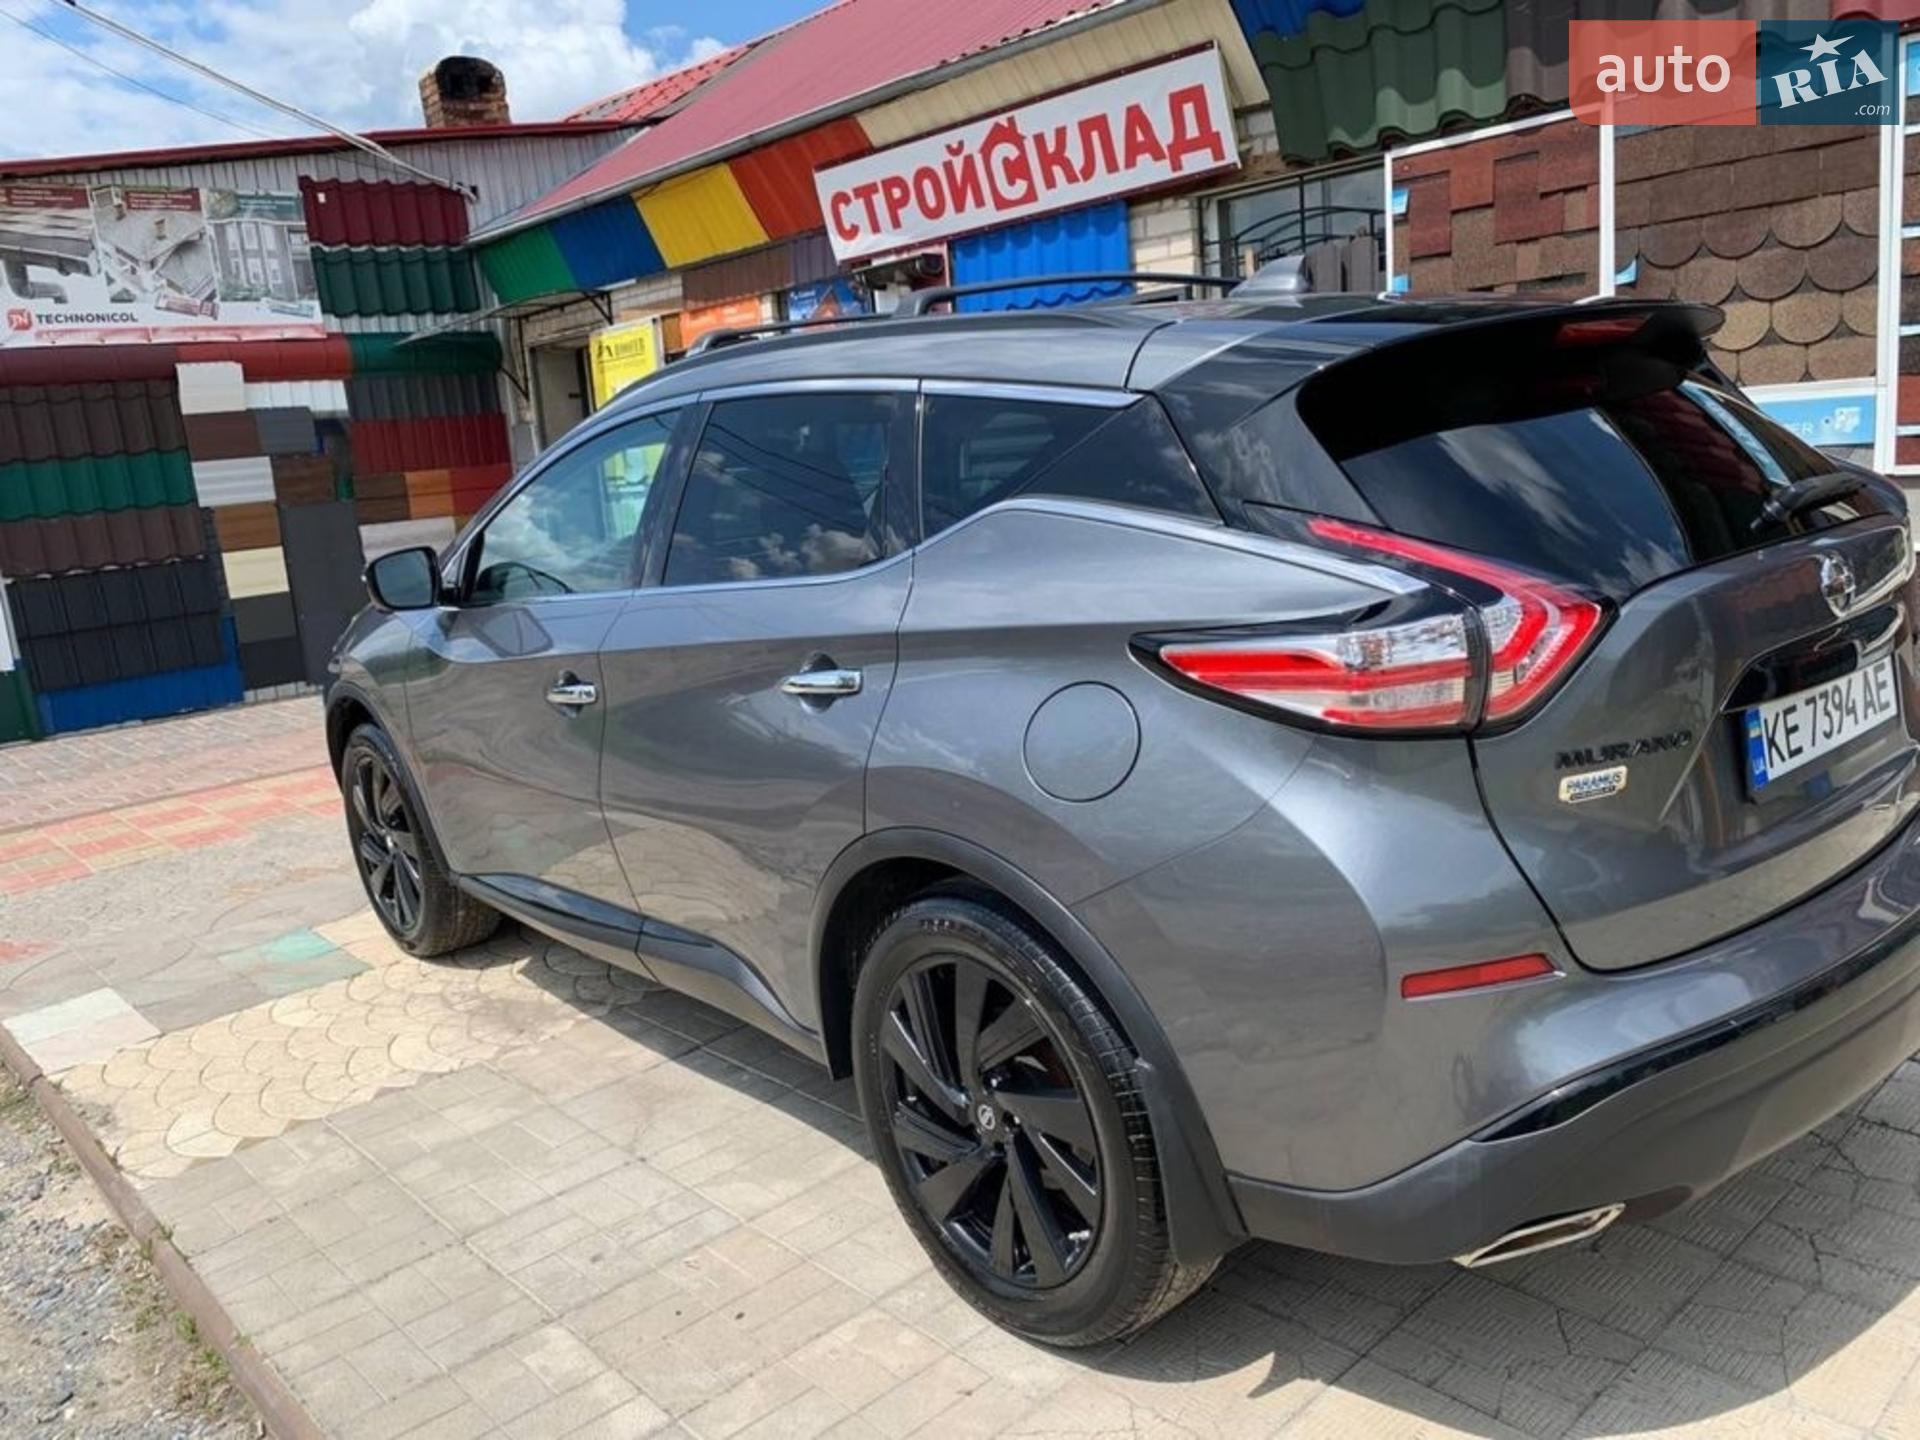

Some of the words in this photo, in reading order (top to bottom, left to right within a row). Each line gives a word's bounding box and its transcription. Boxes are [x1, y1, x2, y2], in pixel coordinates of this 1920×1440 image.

[35, 312, 139, 324] TECHNONICOL
[1764, 704, 1804, 769] KE
[1805, 678, 1859, 748] 7394
[1863, 661, 1891, 721] AE
[1554, 731, 1692, 769] MURANO
[1567, 772, 1623, 794] PARAMUS
